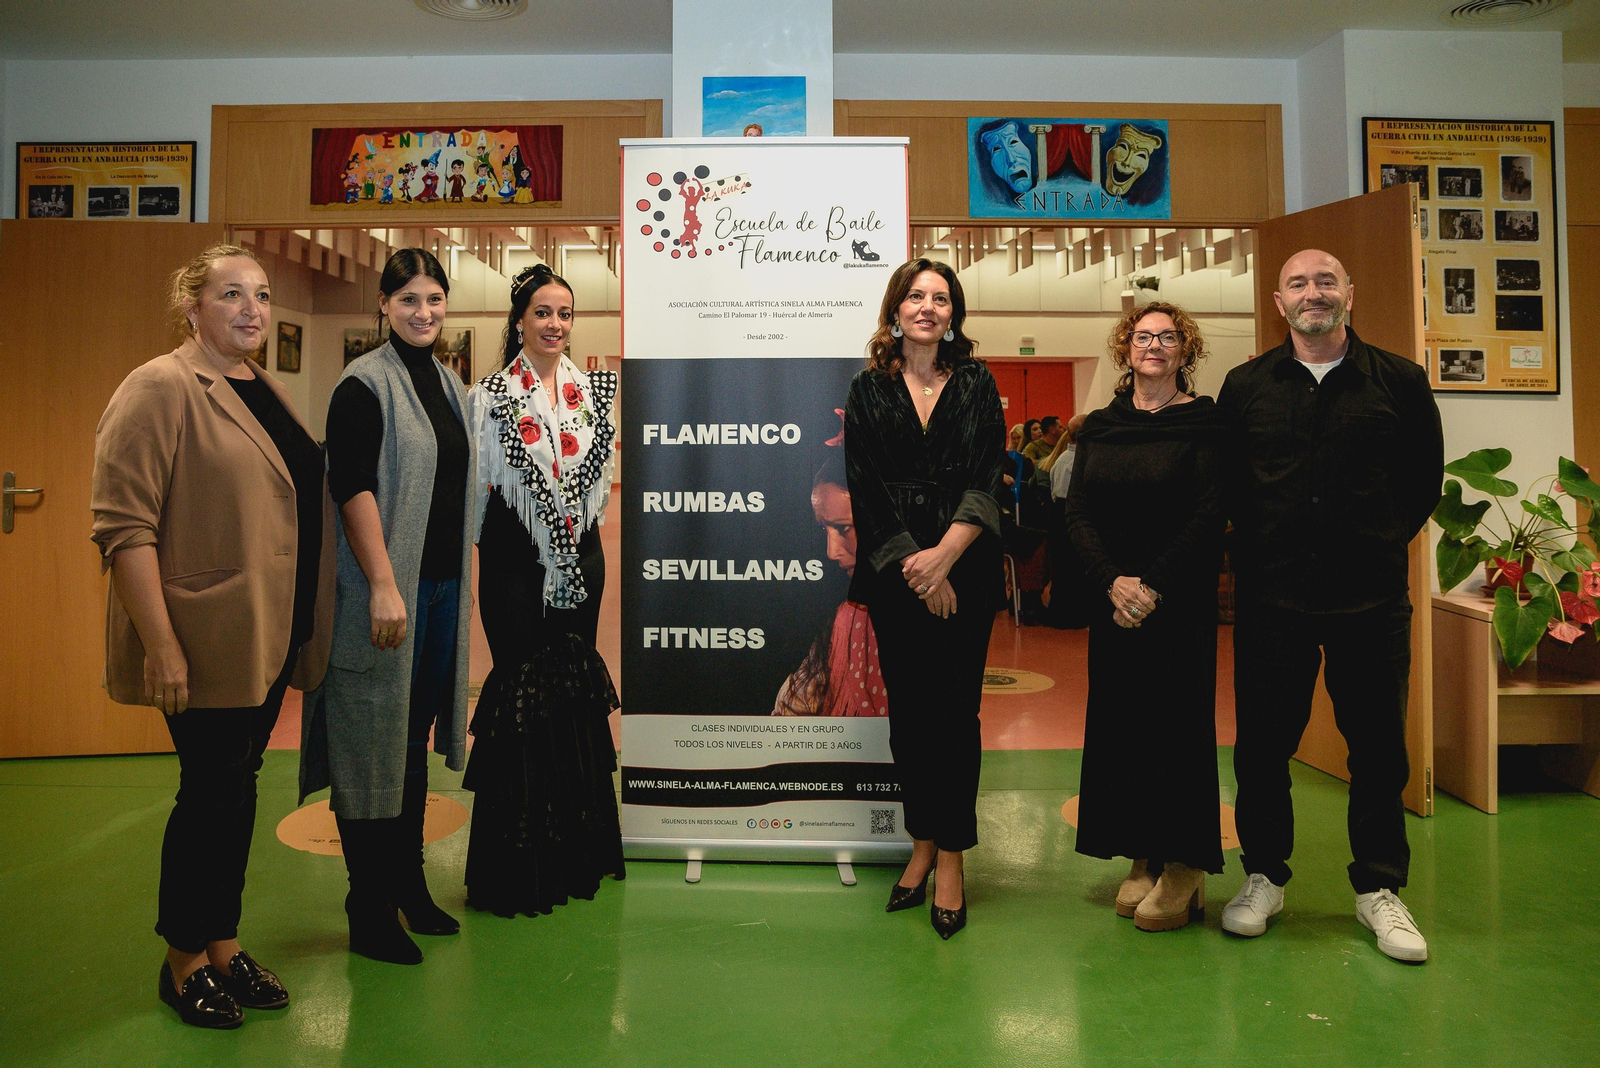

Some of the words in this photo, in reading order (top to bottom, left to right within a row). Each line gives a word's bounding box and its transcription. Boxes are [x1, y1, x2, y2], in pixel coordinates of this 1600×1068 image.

[1387, 122, 1462, 131] REPRESENTACION
[1465, 124, 1511, 132] HISTORICA
[382, 131, 487, 149] ENTRADA
[1371, 132, 1406, 140] GUERRA
[1408, 133, 1431, 141] CIVIL
[1447, 134, 1494, 142] ANDALUCIA
[1497, 134, 1547, 144] (1936-1939)
[141, 155, 188, 163] (1936-1939)
[704, 190, 718, 201] LA
[720, 181, 749, 196] KUKA
[1014, 191, 1125, 212] ENTRADA
[714, 206, 789, 240] Escuela
[796, 211, 818, 231] de
[826, 206, 885, 243] Baile
[733, 233, 841, 270] Flamenco
[668, 300, 708, 308] ASOCIACIÓN
[745, 300, 780, 308] ARTÍSTICA
[643, 423, 802, 445] FLAMENCO
[643, 491, 765, 513] RUMBAS
[642, 559, 824, 581] SEVILLANAS
[643, 627, 766, 649] FITNESS
[691, 725, 725, 733] CLASES
[727, 725, 788, 733] INDIVIDUALES
[790, 725, 796, 733] Y
[798, 725, 810, 733] EN
[812, 725, 844, 734] GRUPO
[674, 740, 705, 748] TODOS
[706, 740, 724, 748] LOS
[726, 741, 763, 749] NIVELES
[774, 741, 781, 749] A
[782, 741, 814, 750] PARTIR
[816, 742, 829, 750] DE
[830, 742, 836, 750] 3
[837, 740, 863, 750] AÑOS
[628, 780, 844, 792] WWW.SINELA-ALMA-FLAMENCA.WEBNODE.ES
[856, 783, 873, 792] 613
[875, 783, 892, 792] 732
